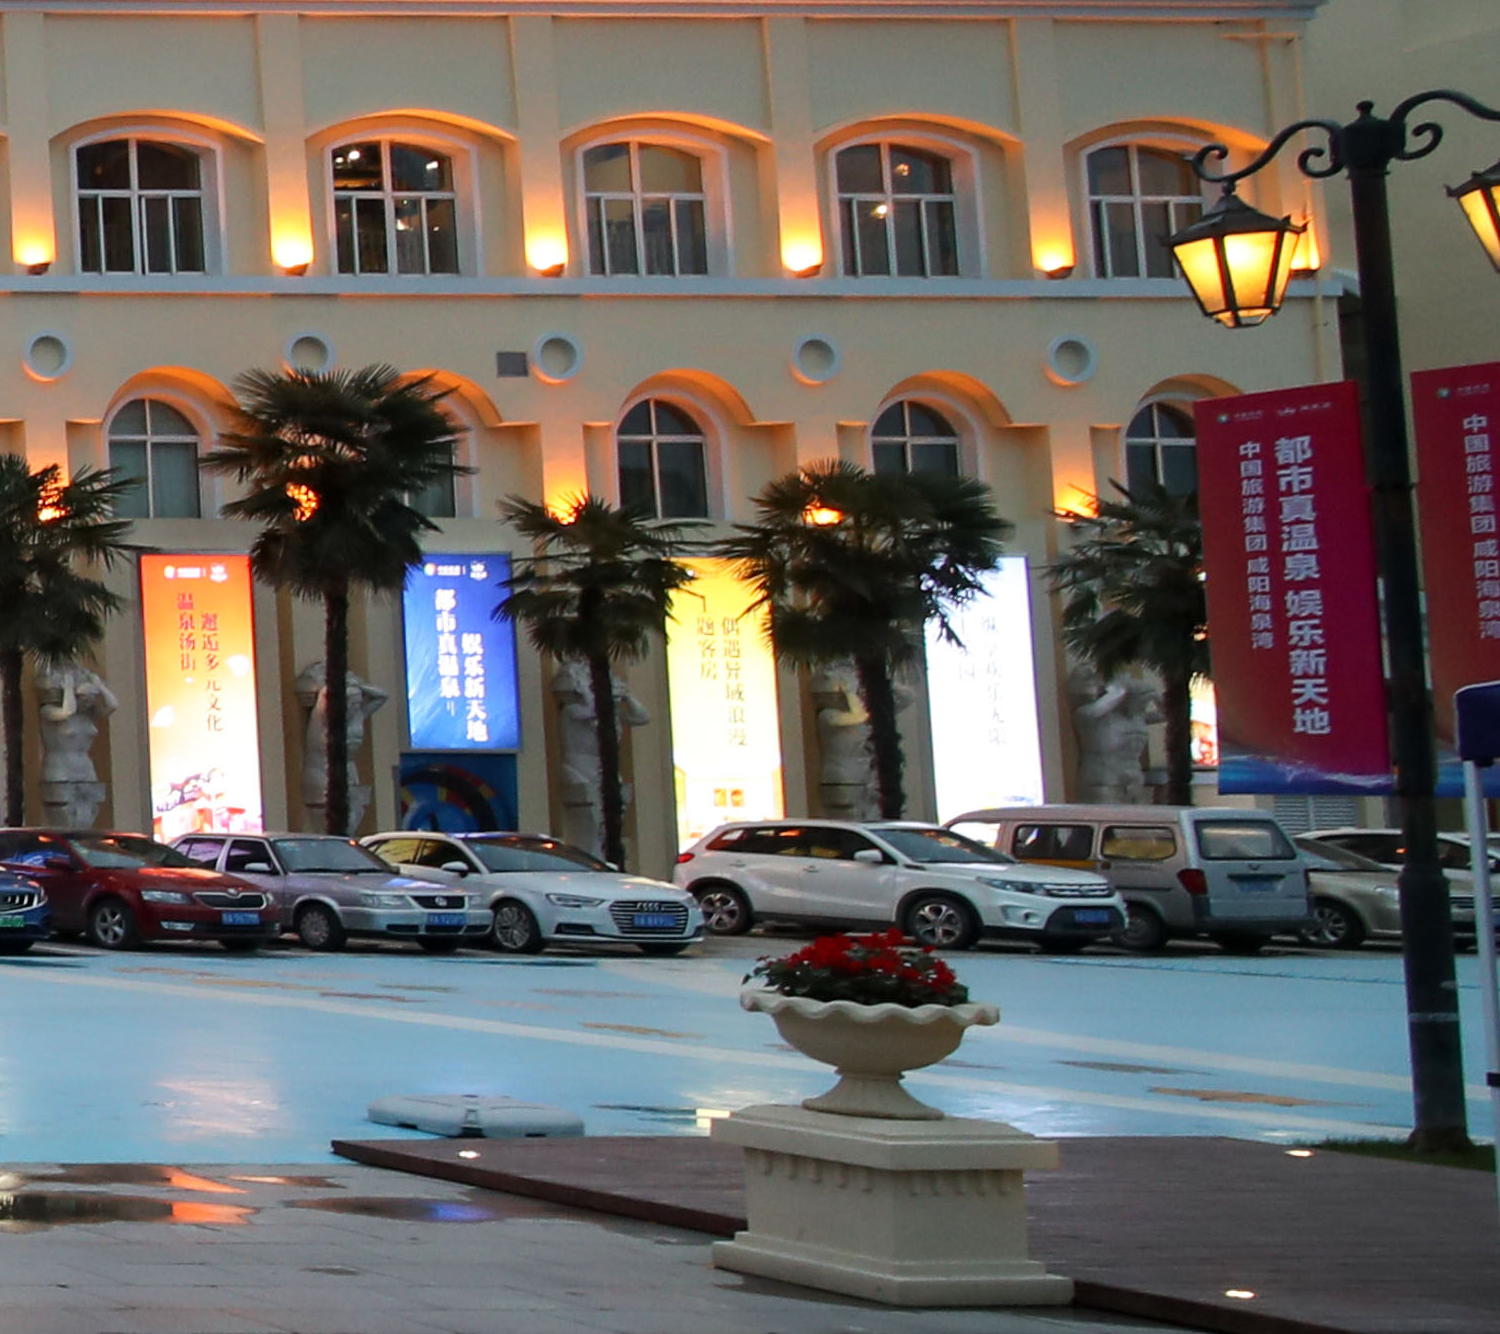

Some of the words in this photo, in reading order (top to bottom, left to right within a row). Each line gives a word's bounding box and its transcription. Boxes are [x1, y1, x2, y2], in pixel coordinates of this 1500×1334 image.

[1239, 441, 1268, 553] 中国旅游集团
[1274, 435, 1321, 581] 都市真温泉
[1463, 413, 1497, 534] 中国旅游集团
[176, 591, 197, 672] 温泉汤街
[434, 588, 461, 698] 都市真温泉
[1247, 557, 1274, 650] 咸阳海泉湾
[200, 612, 223, 732] 邂逅多元文化
[461, 632, 489, 743] 娱乐新天地
[1285, 589, 1332, 736] 娱乐新天地
